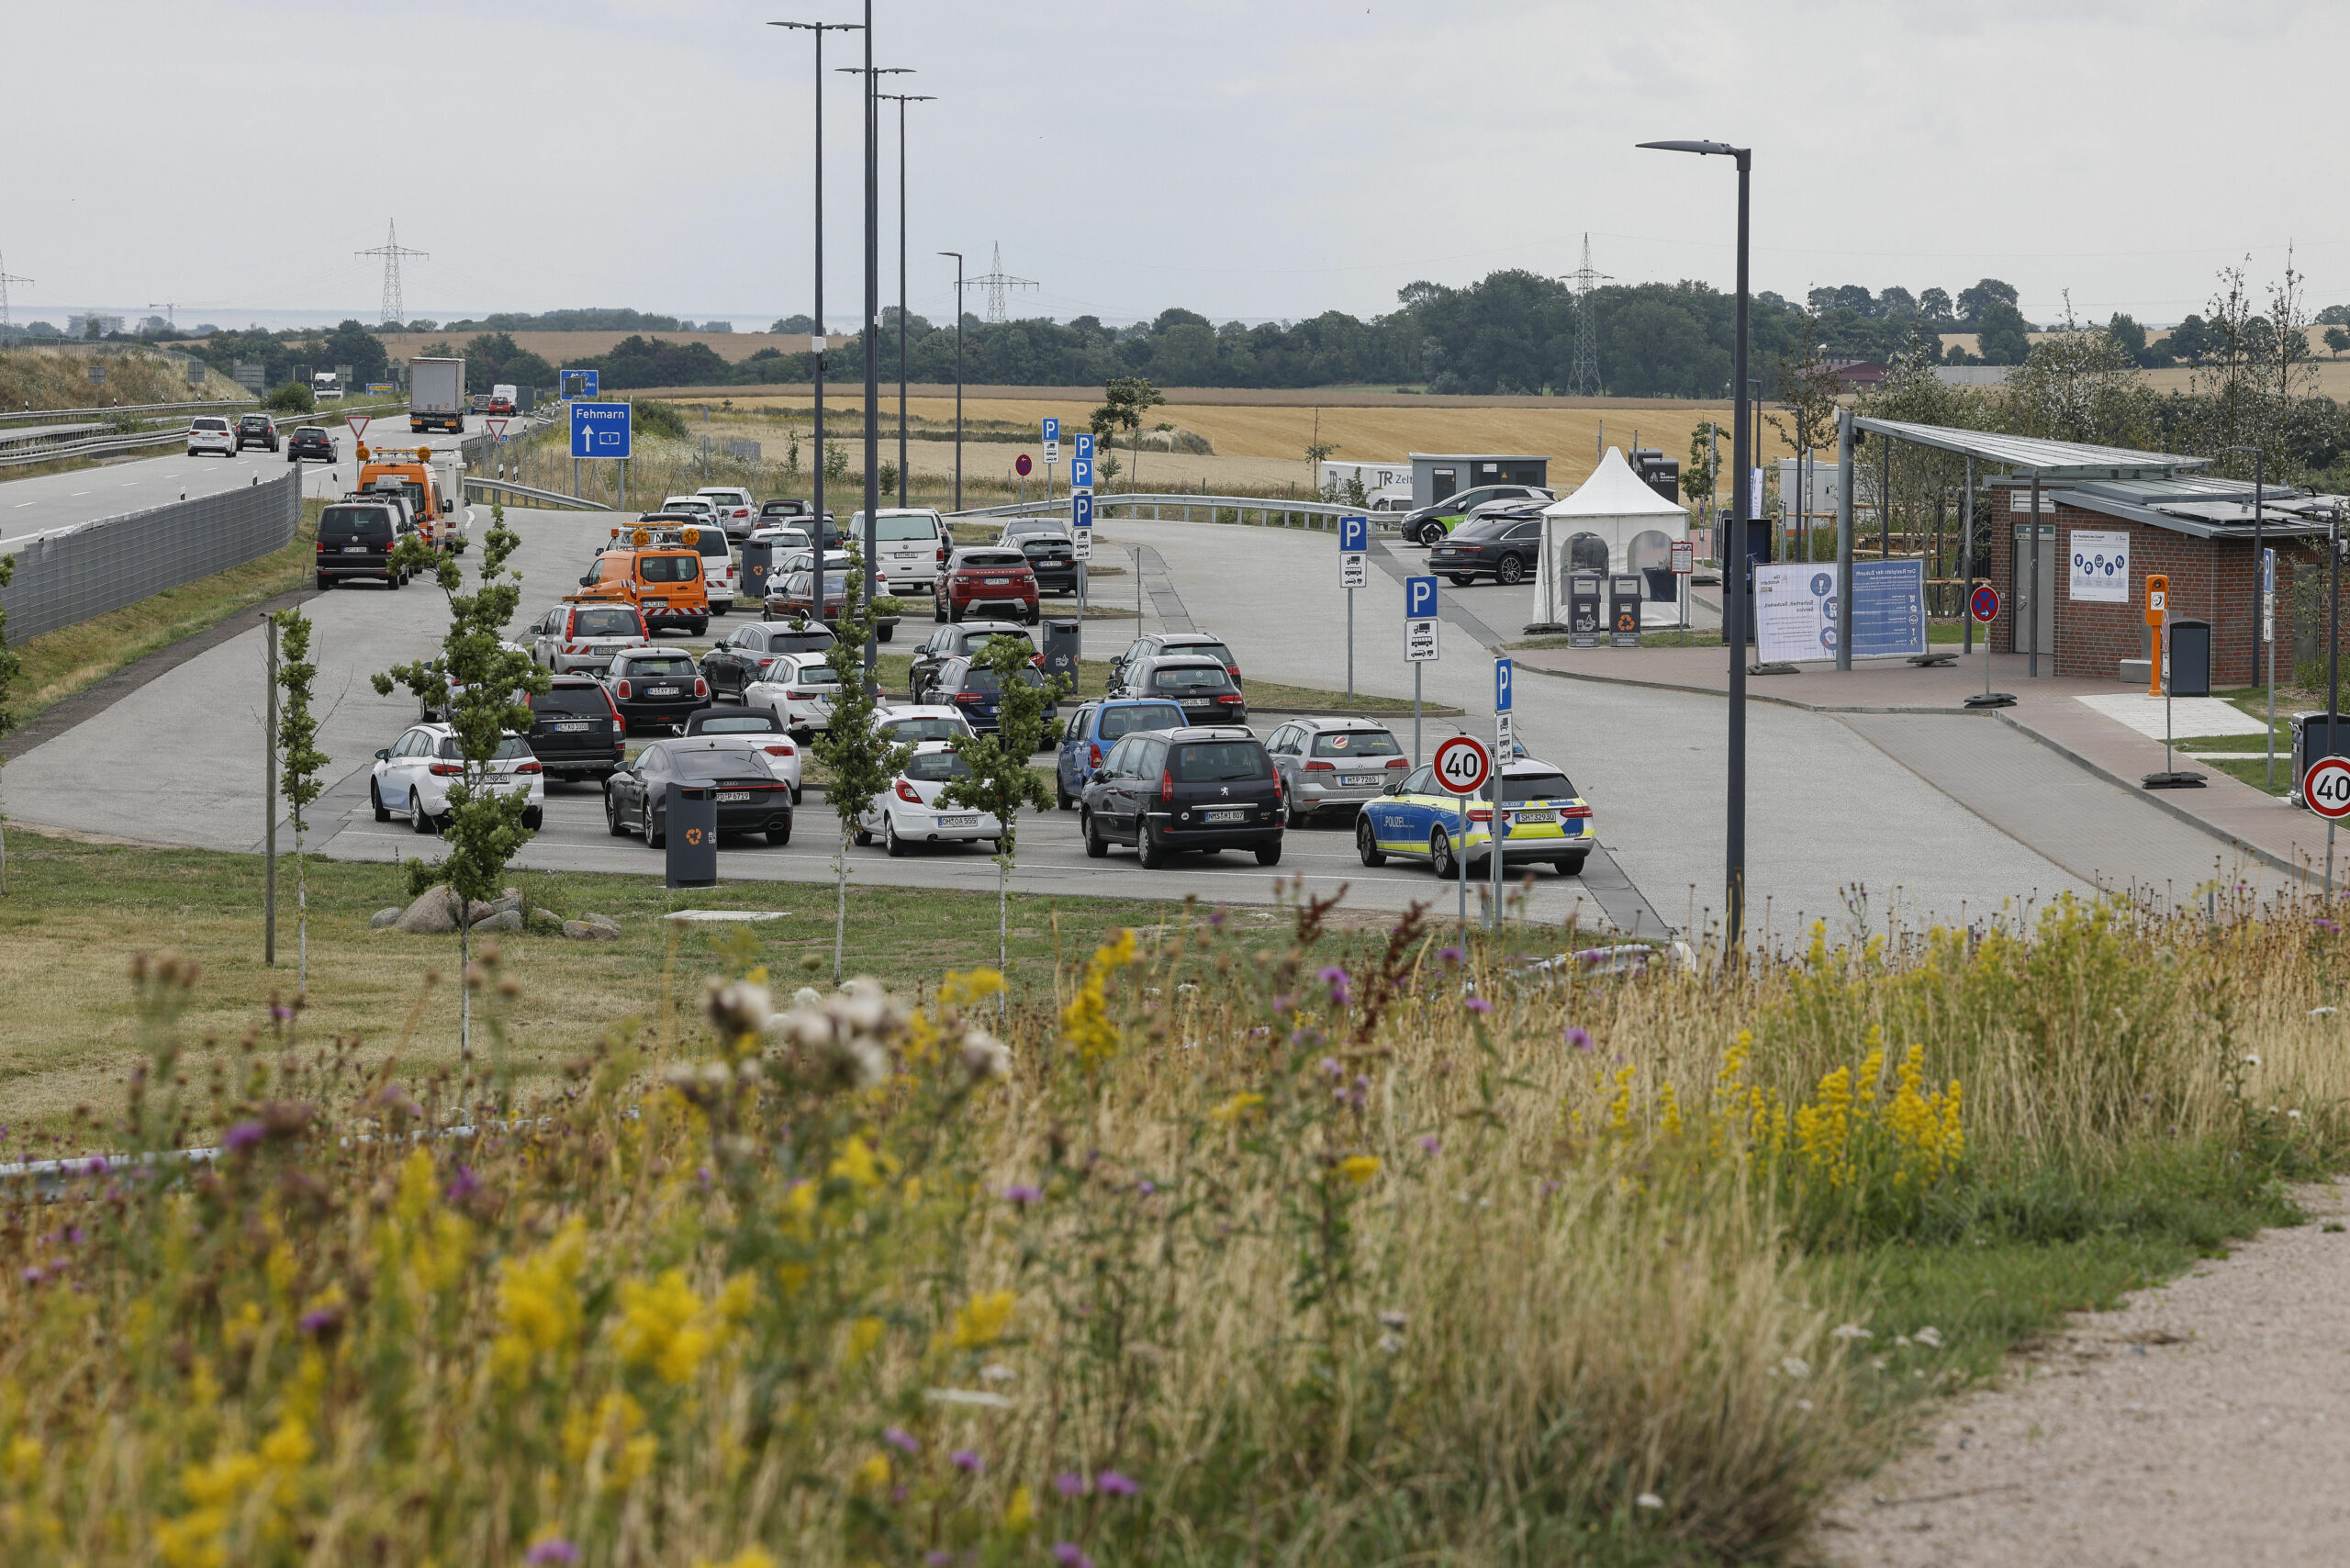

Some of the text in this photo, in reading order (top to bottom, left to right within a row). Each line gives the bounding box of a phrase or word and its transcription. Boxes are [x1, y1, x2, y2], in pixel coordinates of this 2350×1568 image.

[576, 409, 624, 420] Fehmarn
[1046, 420, 1056, 438] P
[1079, 437, 1090, 456] P
[1076, 462, 1088, 483] P
[1377, 471, 1414, 488] TR Zelt
[1077, 498, 1089, 523] P
[1346, 521, 1361, 547] P
[2265, 554, 2270, 587] P
[1413, 581, 1431, 613] P
[1499, 666, 1508, 705] P
[1446, 752, 1478, 778] 40
[2316, 775, 2350, 801] 40
[1385, 815, 1404, 828] POLIZEI
[1520, 812, 1554, 822] SH 32930
